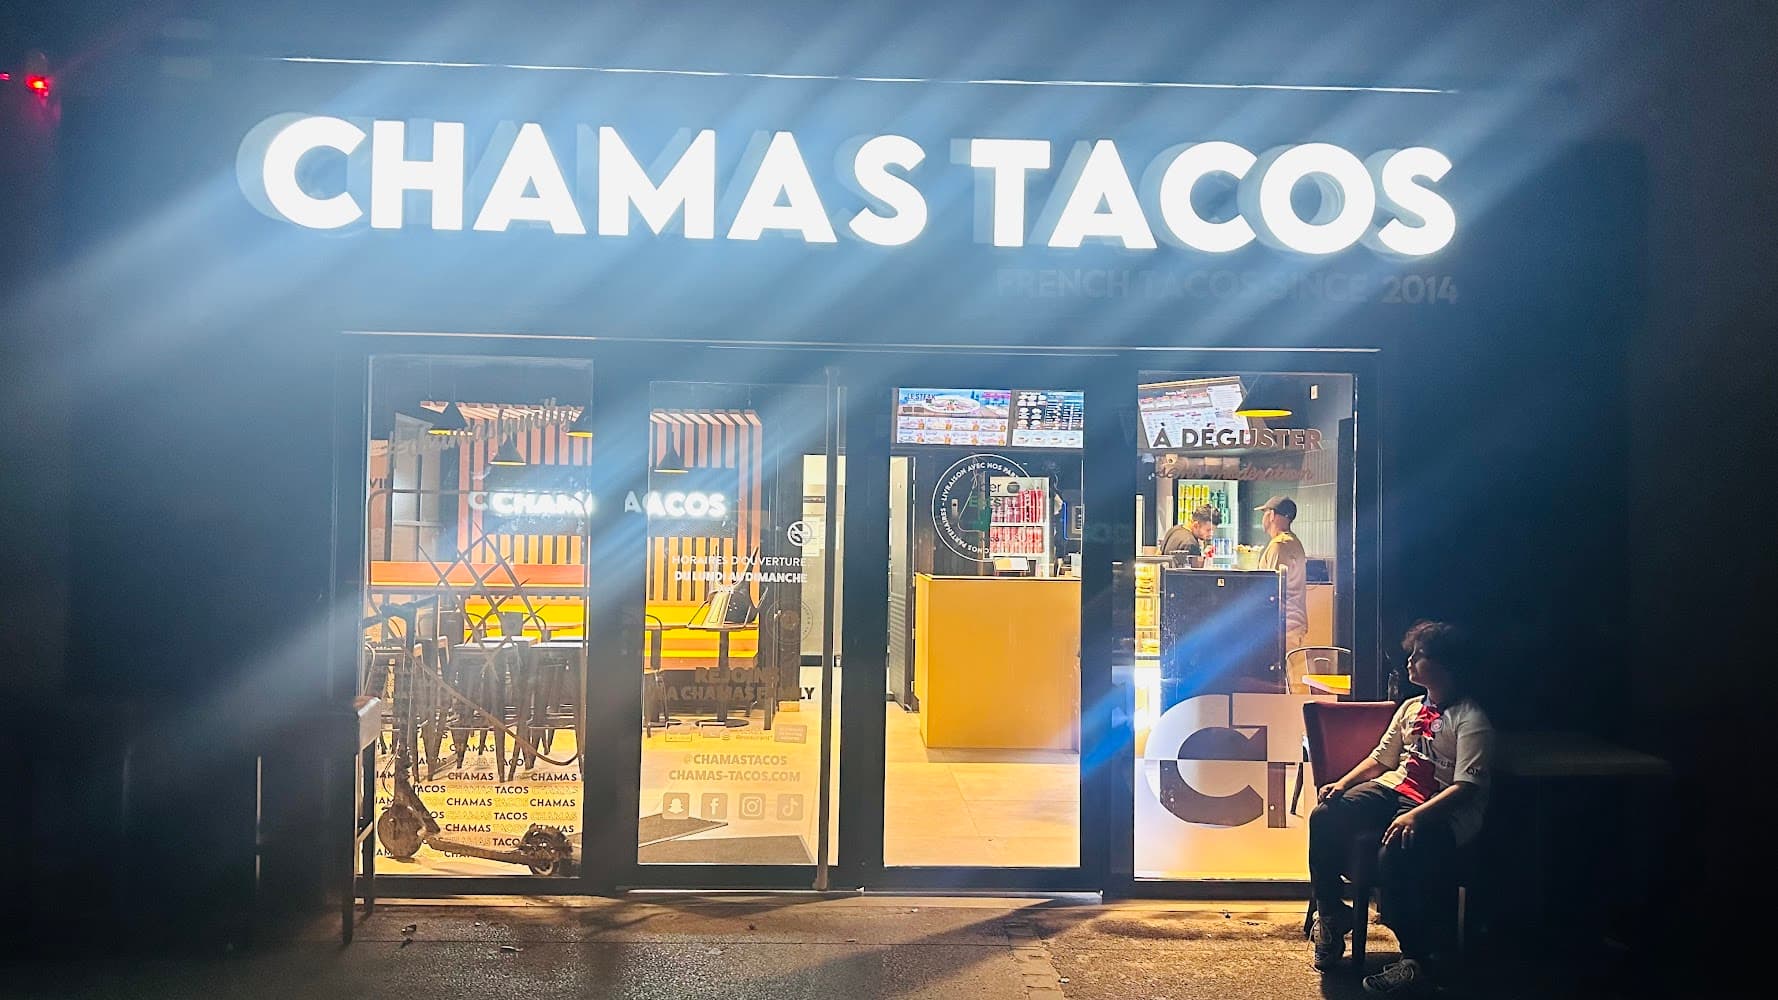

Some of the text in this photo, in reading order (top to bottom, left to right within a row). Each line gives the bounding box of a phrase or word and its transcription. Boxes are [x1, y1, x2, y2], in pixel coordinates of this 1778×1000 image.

[264, 117, 1455, 255] CHAMAS TACOS
[1381, 274, 1457, 304] 2014
[1153, 422, 1171, 447] À
[1182, 422, 1322, 450] DÉGUSTER
[941, 468, 966, 501] LIVRAISON
[987, 462, 1003, 471] NOS
[684, 754, 787, 766] @CHAMASTACOS
[447, 772, 577, 782] CHAMAS CHAMAS
[669, 769, 801, 783] CHAMAS-TACOS.COM
[495, 786, 529, 794] TACOS
[446, 798, 493, 807] CHAMAS
[530, 798, 576, 808] CHAMAS
[494, 811, 528, 820] TACOS
[445, 823, 491, 833] CHAMAS
[492, 837, 521, 847] TACO
